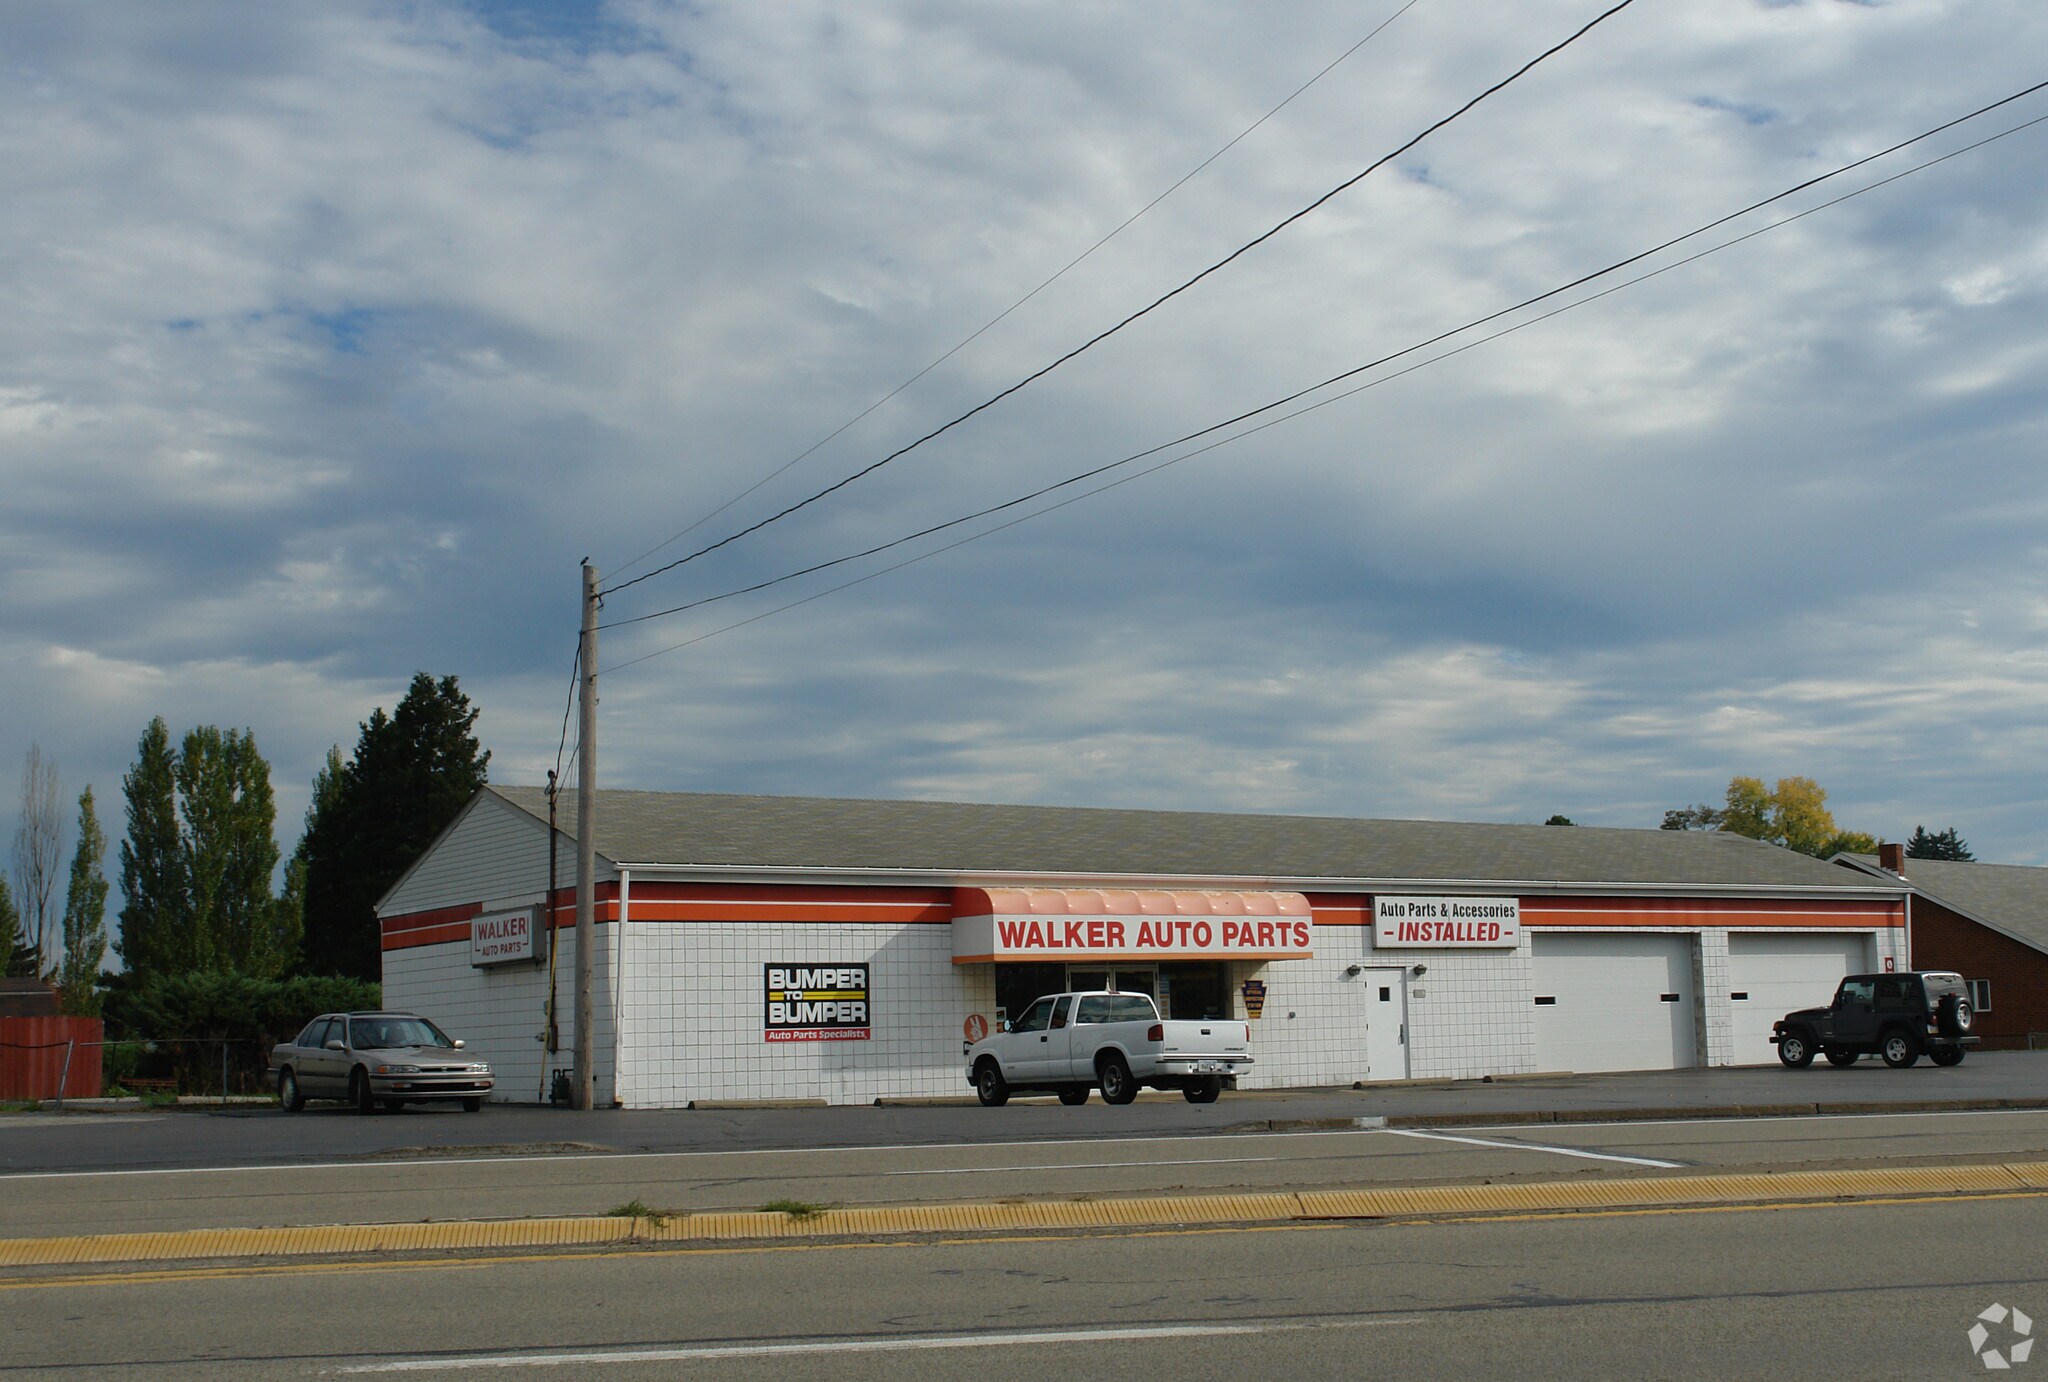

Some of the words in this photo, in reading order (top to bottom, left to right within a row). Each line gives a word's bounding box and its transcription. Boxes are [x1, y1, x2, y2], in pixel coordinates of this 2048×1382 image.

[1380, 902, 1405, 917] Auto
[1408, 903, 1437, 917] Parts
[1440, 904, 1448, 917] &
[1452, 903, 1515, 918] Accessories
[478, 917, 526, 940] WALKER
[998, 921, 1125, 948] WALKER
[1136, 921, 1213, 948] AUTO
[1222, 922, 1310, 948] PARTS
[1398, 922, 1500, 941] INSTALLED
[482, 945, 498, 957] AUTO
[500, 942, 521, 954] PARTS
[769, 969, 866, 989] BUMPER
[784, 991, 802, 1000] TO
[769, 1002, 866, 1023] BUMPER
[793, 1031, 817, 1039] Parts
[819, 1030, 864, 1039] Specialists
